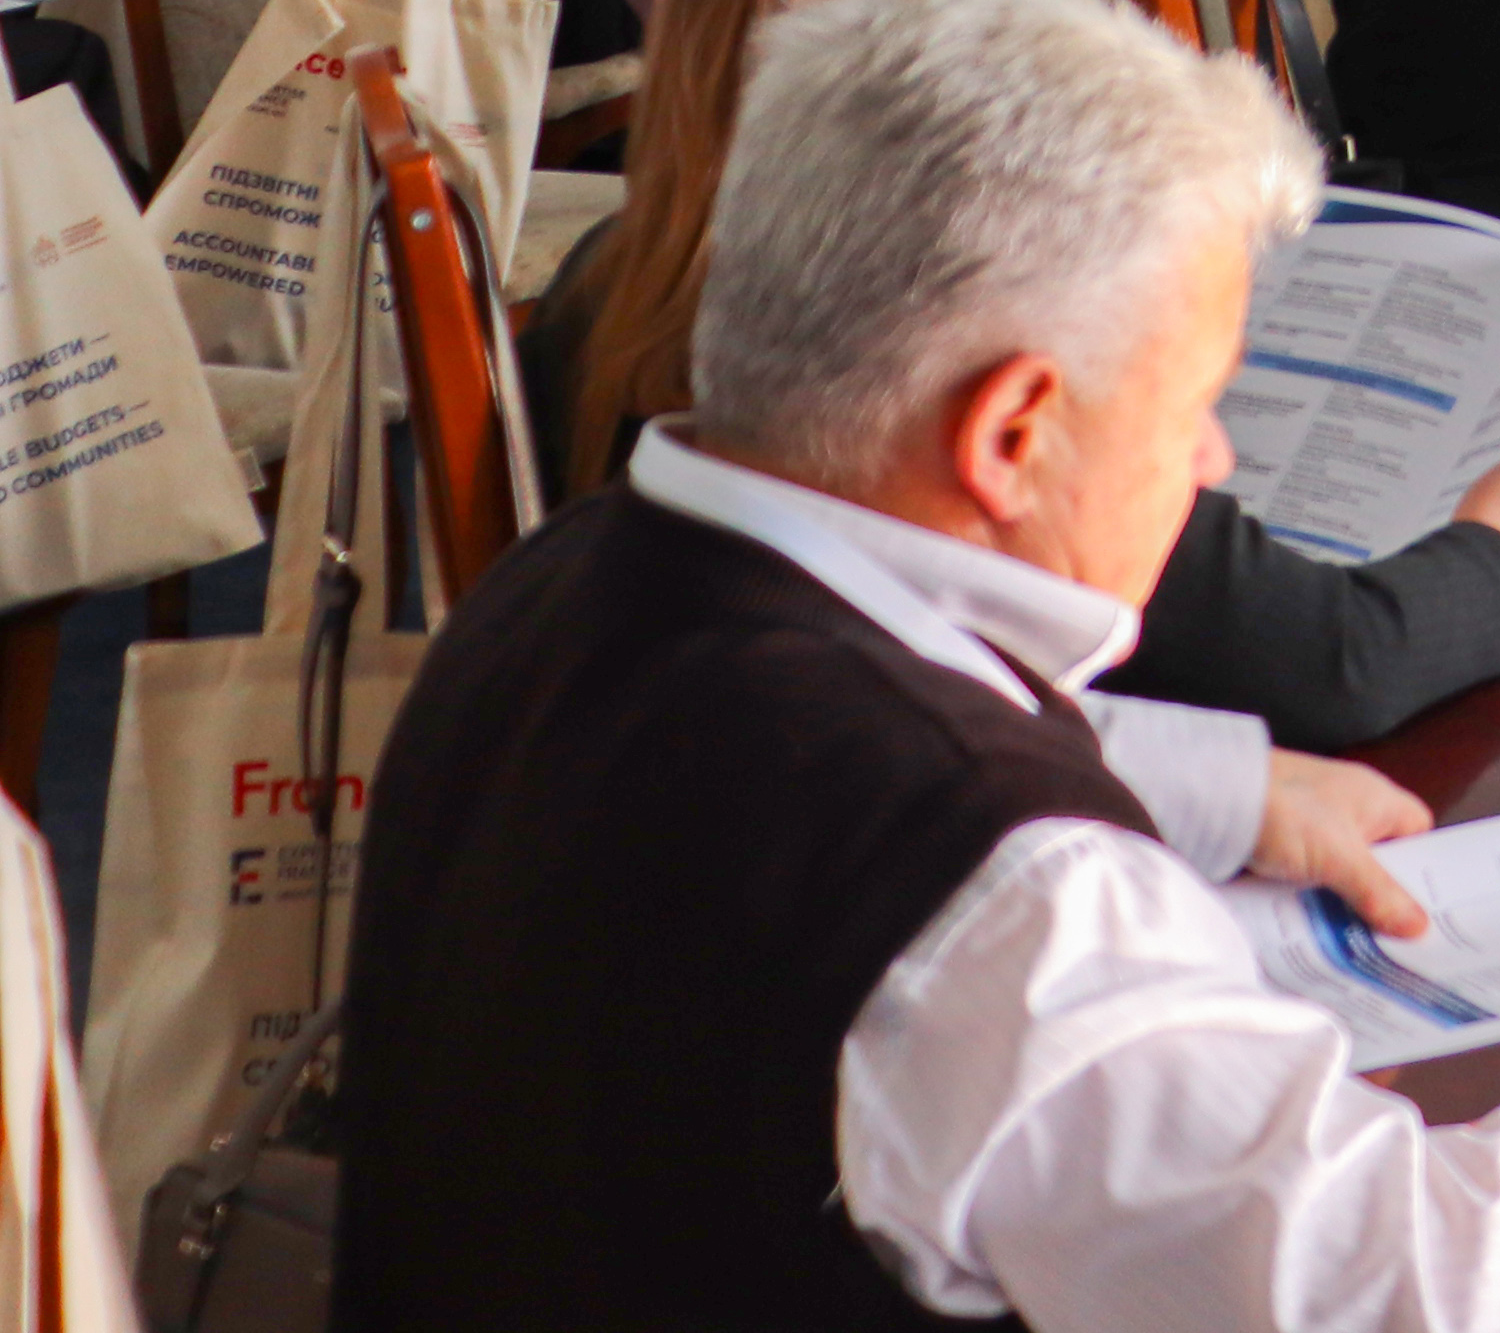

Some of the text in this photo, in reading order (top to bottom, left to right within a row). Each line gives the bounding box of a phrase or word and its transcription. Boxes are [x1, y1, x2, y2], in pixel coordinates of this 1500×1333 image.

[203, 189, 321, 228] СПРОМОЖ
[210, 165, 319, 200] ПІДЗВІТНІ
[165, 254, 305, 297] EMPOWERED
[10, 354, 118, 413] ГРОМАДИ
[12, 419, 165, 495] COMMUNITIES
[25, 404, 125, 460] BUDGETS
[233, 761, 365, 819] Fran
